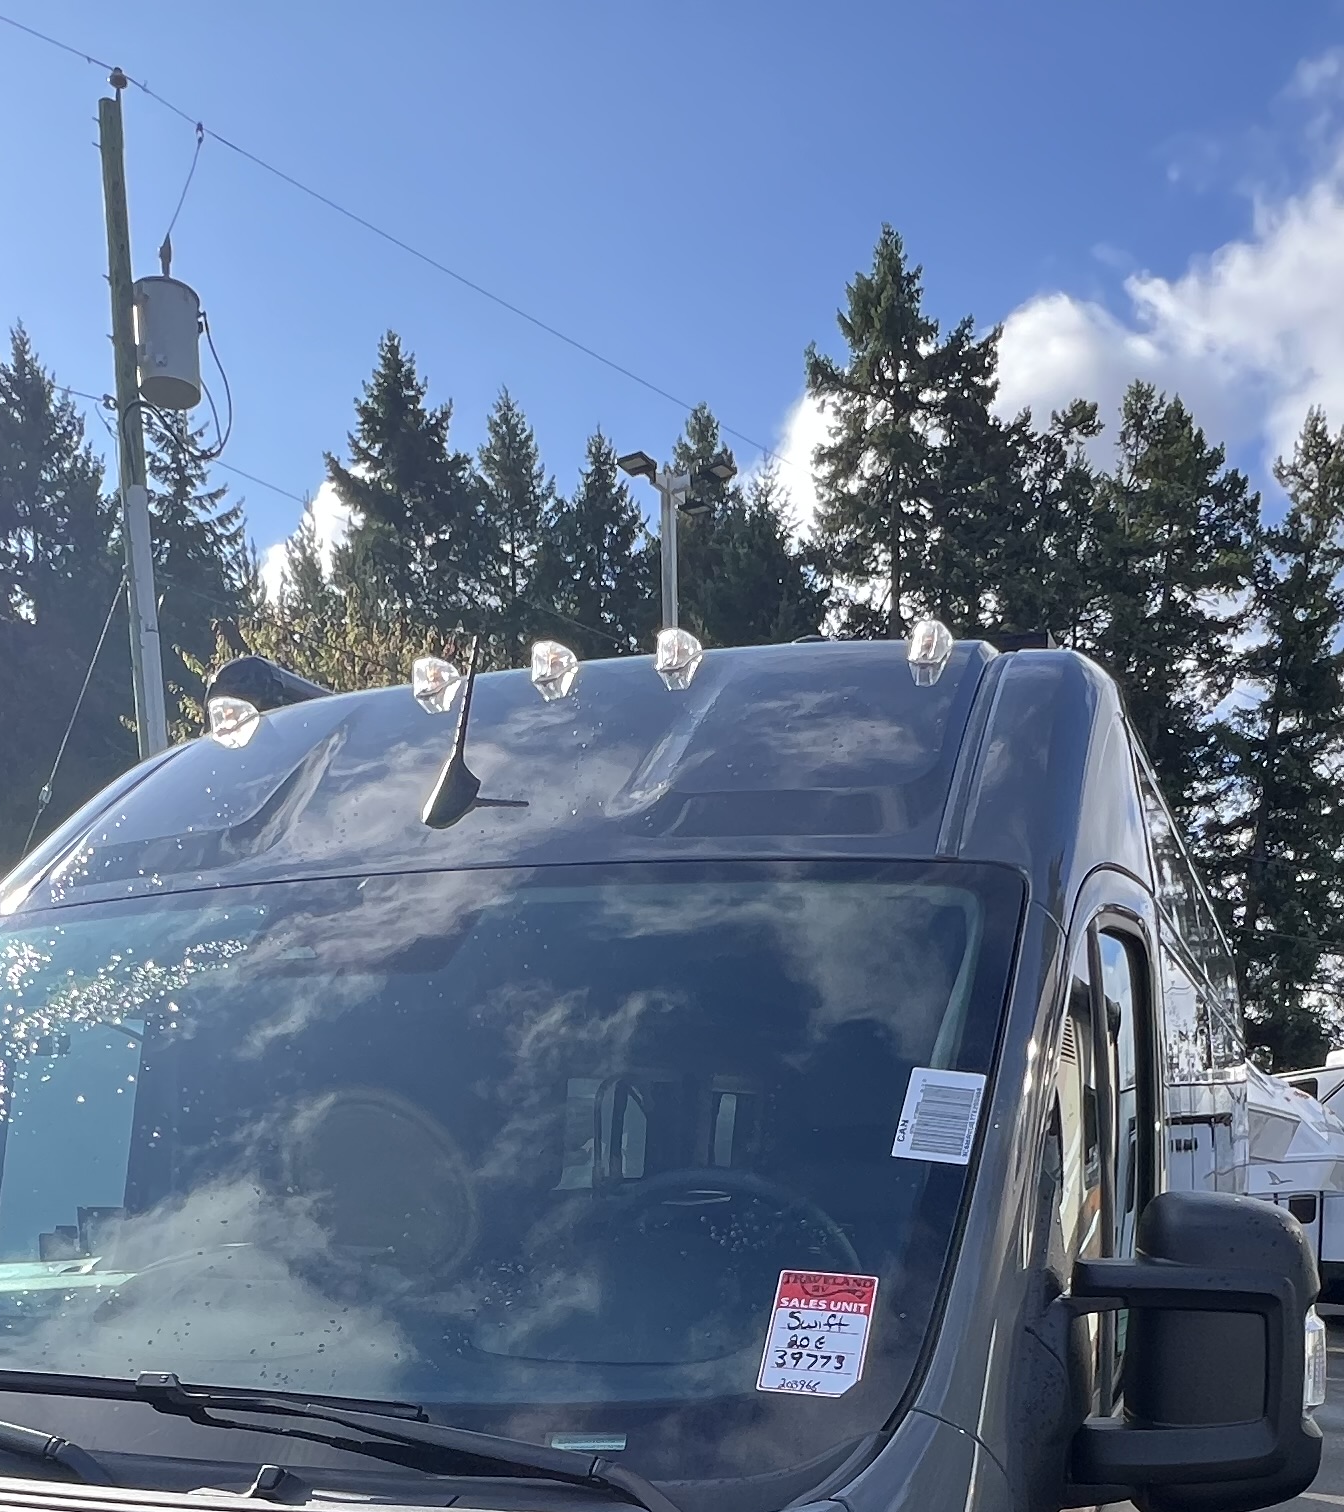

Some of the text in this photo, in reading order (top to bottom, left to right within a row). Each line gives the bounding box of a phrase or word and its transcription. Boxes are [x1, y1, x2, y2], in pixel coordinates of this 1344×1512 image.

[782, 1273, 873, 1288] TRAVELAND
[780, 1297, 868, 1312] SALES UNIT
[787, 1311, 850, 1332] Swift
[774, 1350, 845, 1370] 39773
